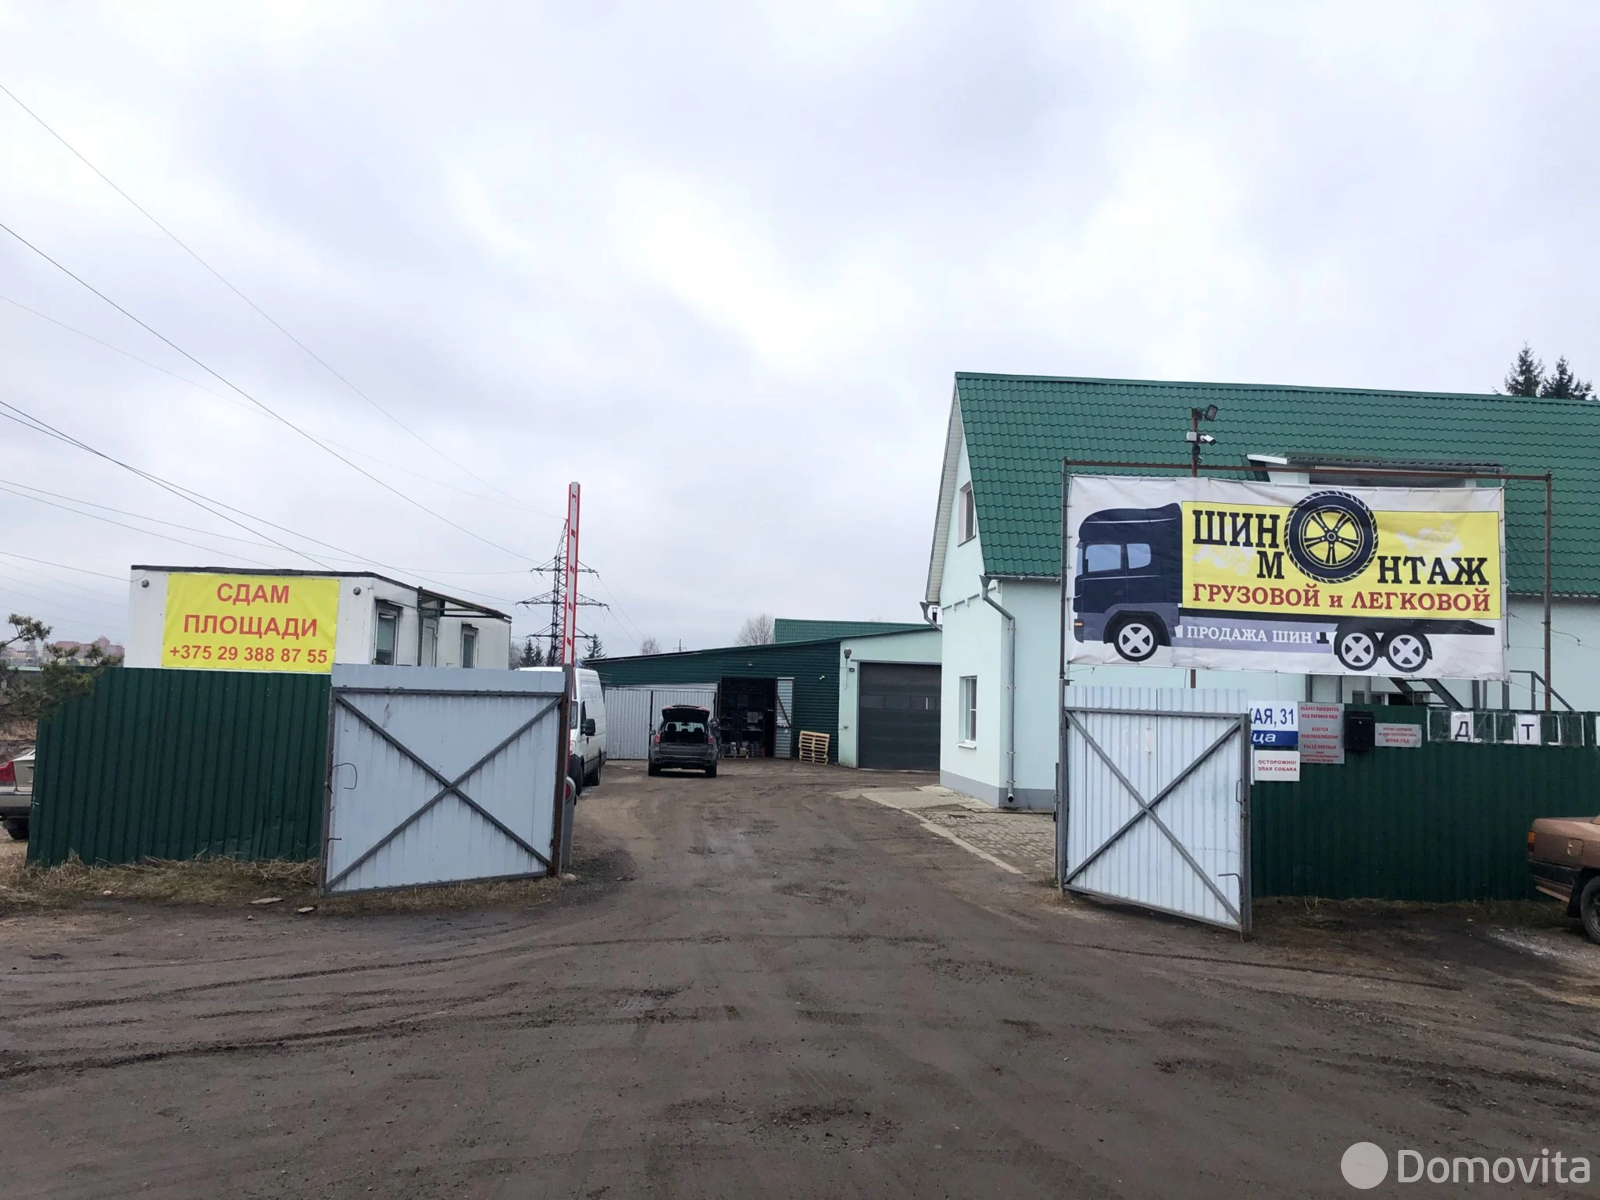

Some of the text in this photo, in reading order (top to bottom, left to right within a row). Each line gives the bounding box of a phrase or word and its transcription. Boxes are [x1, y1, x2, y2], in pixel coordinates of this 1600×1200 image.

[1192, 509, 1281, 549] ШИН
[216, 583, 290, 606] СДАМ
[1192, 582, 1490, 612] ГРУЗОВОЙ и ЛЕГКОВОЙ
[183, 614, 318, 640] ПЛОЩАДИ
[1186, 625, 1313, 644] ПРОДАЖА ШИН
[169, 644, 328, 664] +375 29 388 87 55
[1280, 708, 1294, 725] 31
[1454, 721, 1535, 741] Д Т
